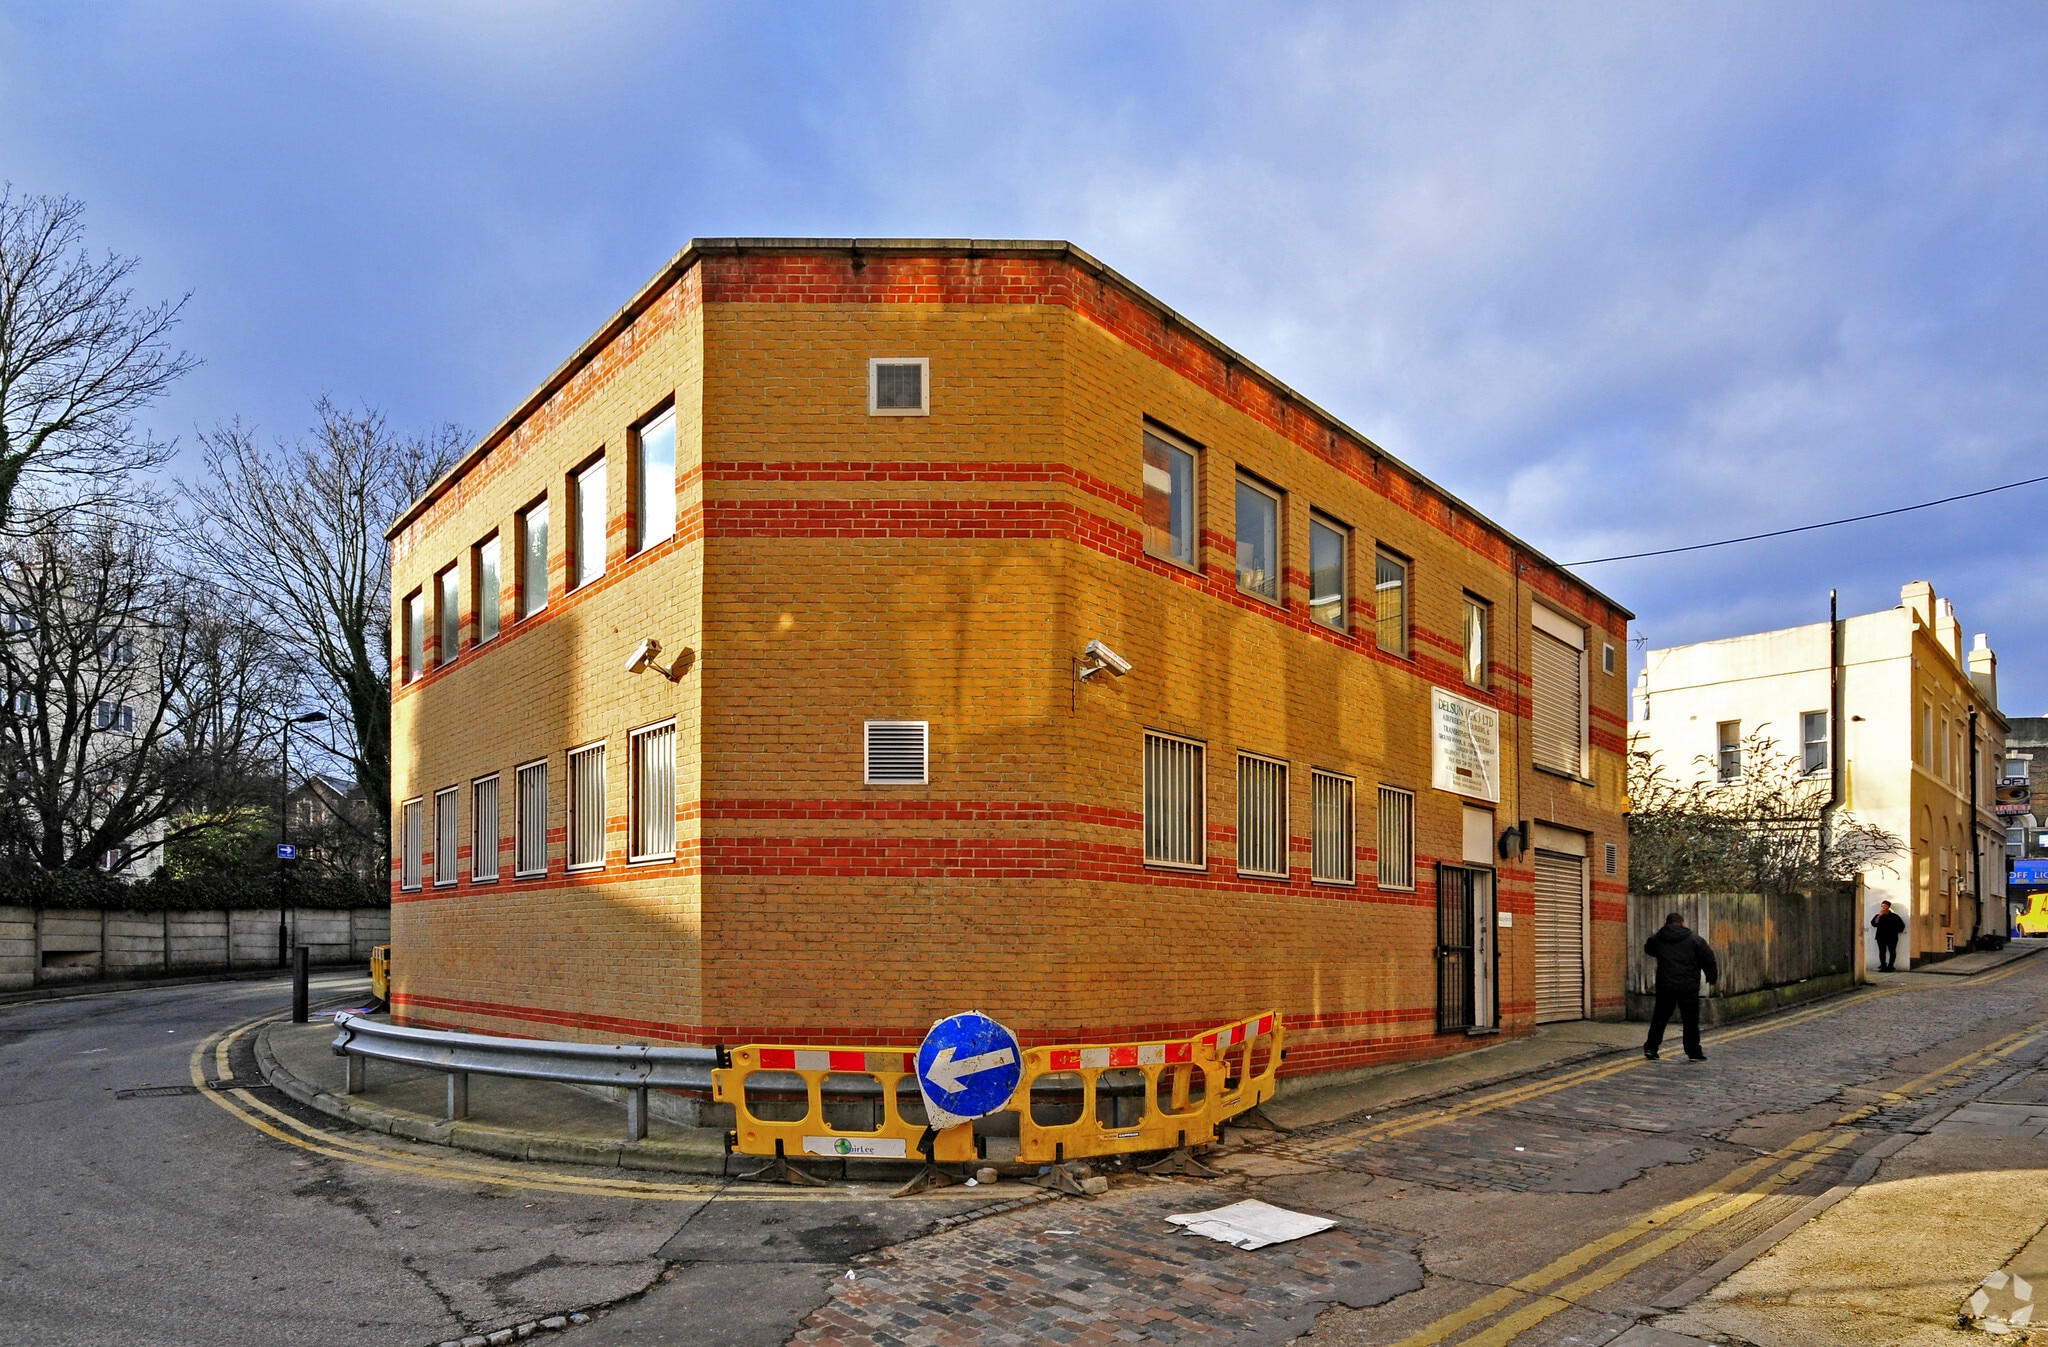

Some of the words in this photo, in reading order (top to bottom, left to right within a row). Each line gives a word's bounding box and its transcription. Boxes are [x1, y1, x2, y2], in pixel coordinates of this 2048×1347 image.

[1438, 698, 1464, 717] DELSUN
[1482, 714, 1494, 728] LTD
[1995, 777, 2029, 786] LOFT
[2009, 871, 2028, 879] OFF
